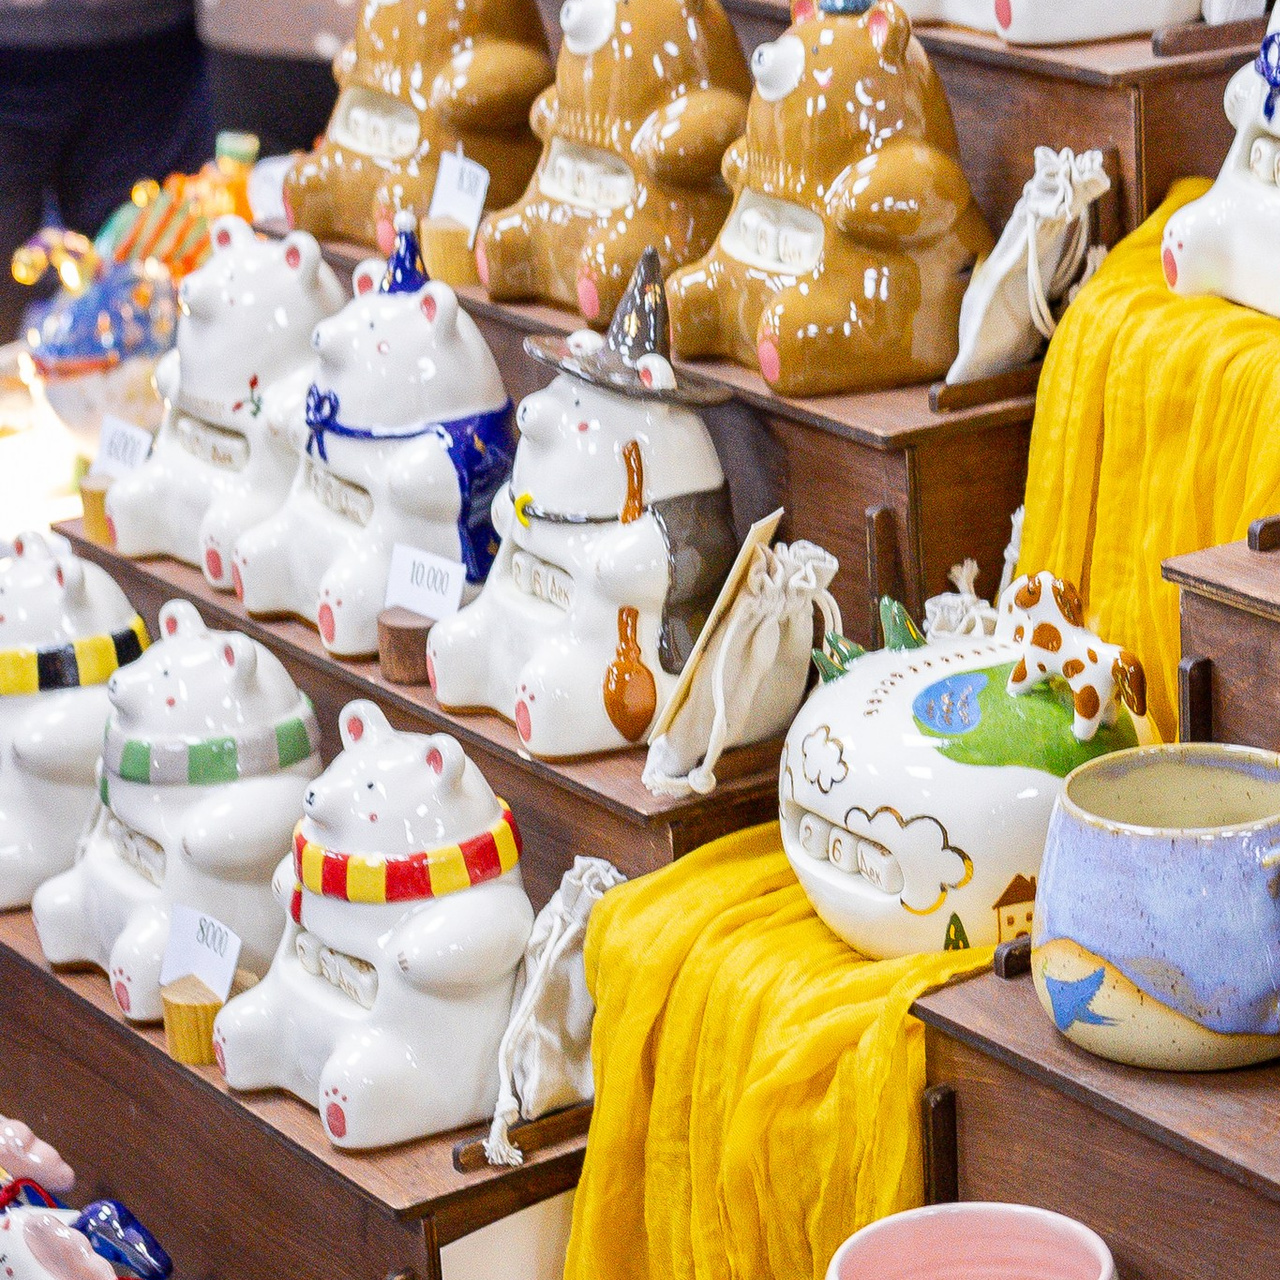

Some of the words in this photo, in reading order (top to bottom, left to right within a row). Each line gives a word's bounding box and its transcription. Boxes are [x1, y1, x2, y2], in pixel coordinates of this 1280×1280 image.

[801, 824, 813, 852] 2
[832, 837, 843, 864] 6
[860, 849, 883, 888] Дек
[195, 917, 229, 958] 8000
